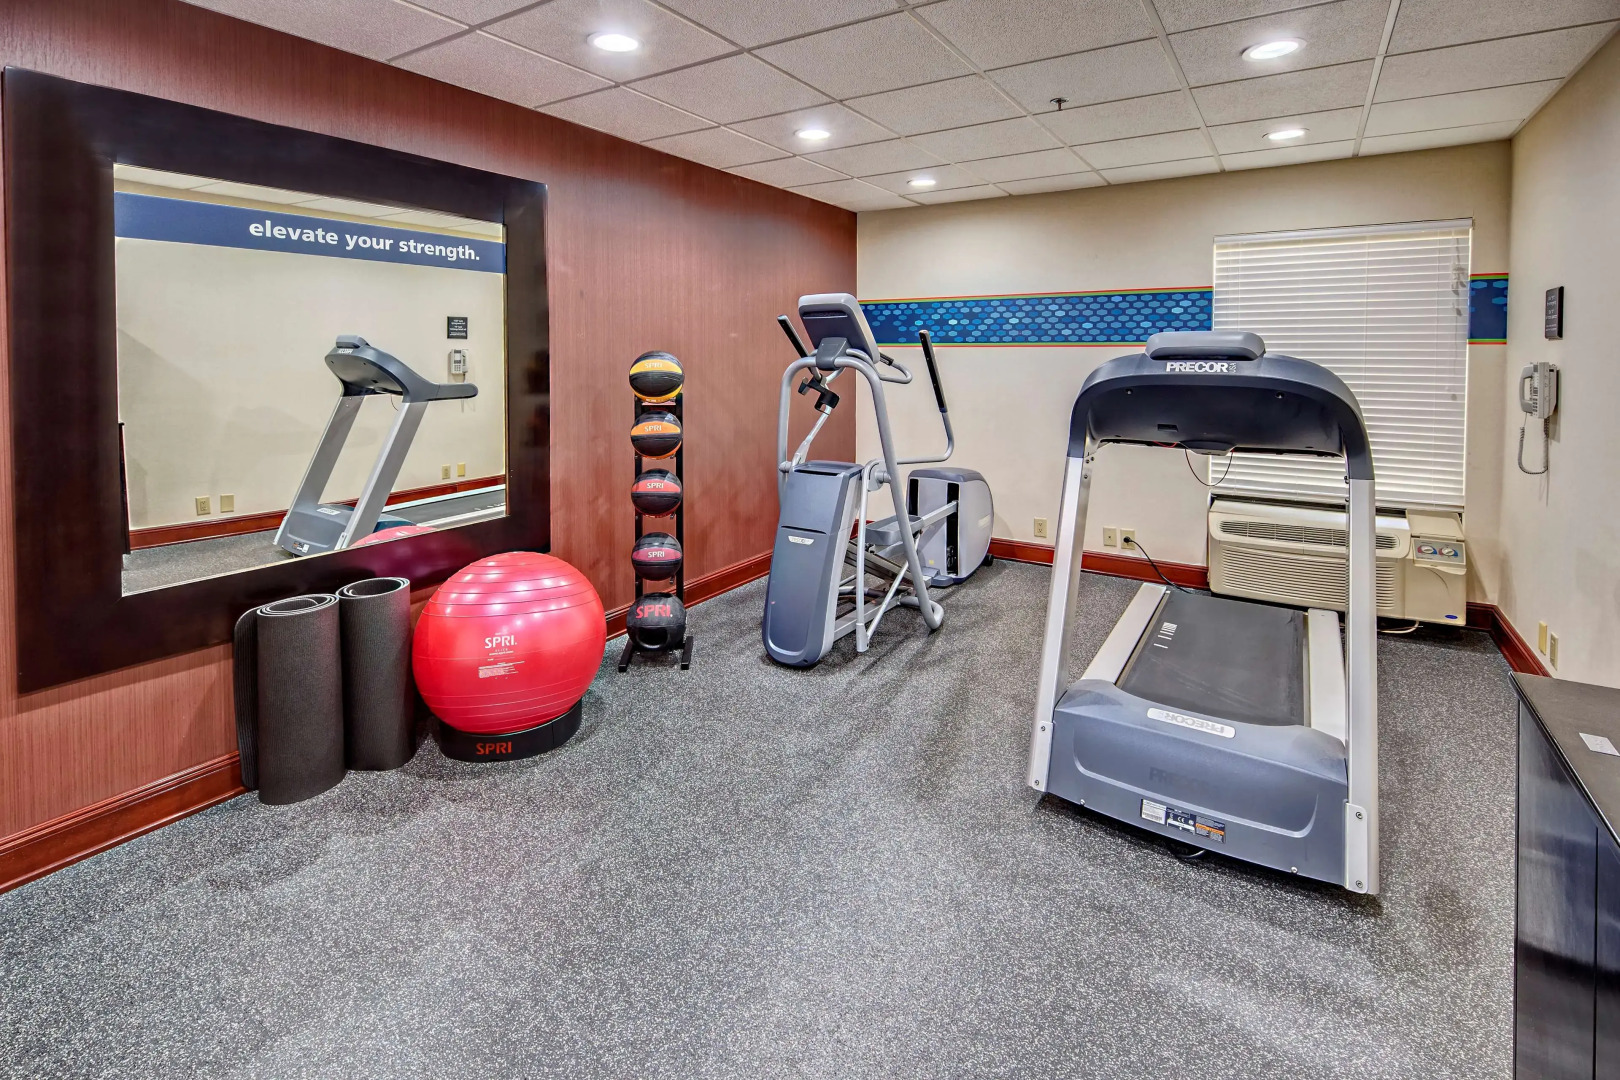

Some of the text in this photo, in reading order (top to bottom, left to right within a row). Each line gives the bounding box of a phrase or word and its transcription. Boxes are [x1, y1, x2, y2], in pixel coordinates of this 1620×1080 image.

[249, 220, 480, 260] elevate your strength.
[1166, 361, 1228, 373] PRECOR
[644, 424, 662, 432] SPRI
[648, 550, 665, 558] SPRI
[1165, 712, 1225, 734] PRECOR
[476, 741, 512, 755] SPRI
